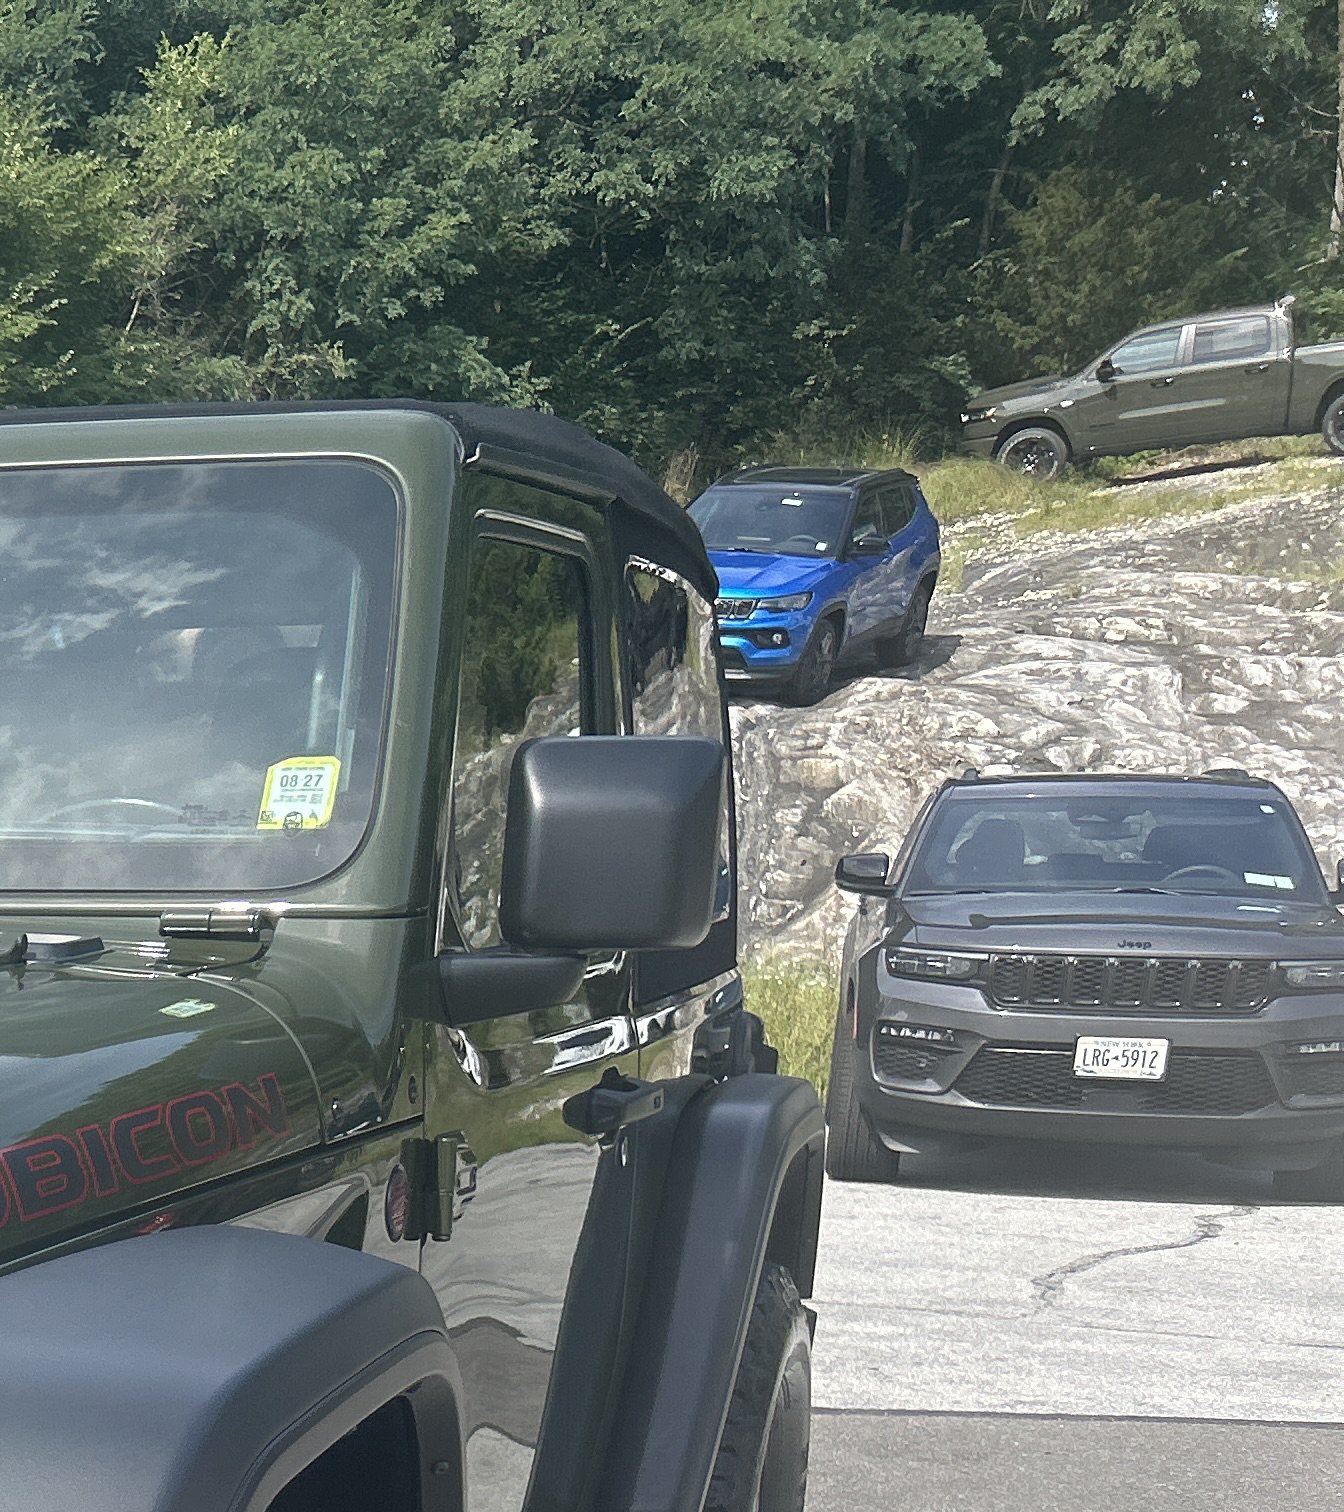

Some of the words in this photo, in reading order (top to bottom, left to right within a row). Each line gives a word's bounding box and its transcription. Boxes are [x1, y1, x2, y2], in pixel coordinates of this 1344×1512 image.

[279, 774, 299, 788] 08
[303, 774, 324, 788] 27
[1082, 1047, 1111, 1067] LRG
[1120, 1048, 1159, 1069] 5912
